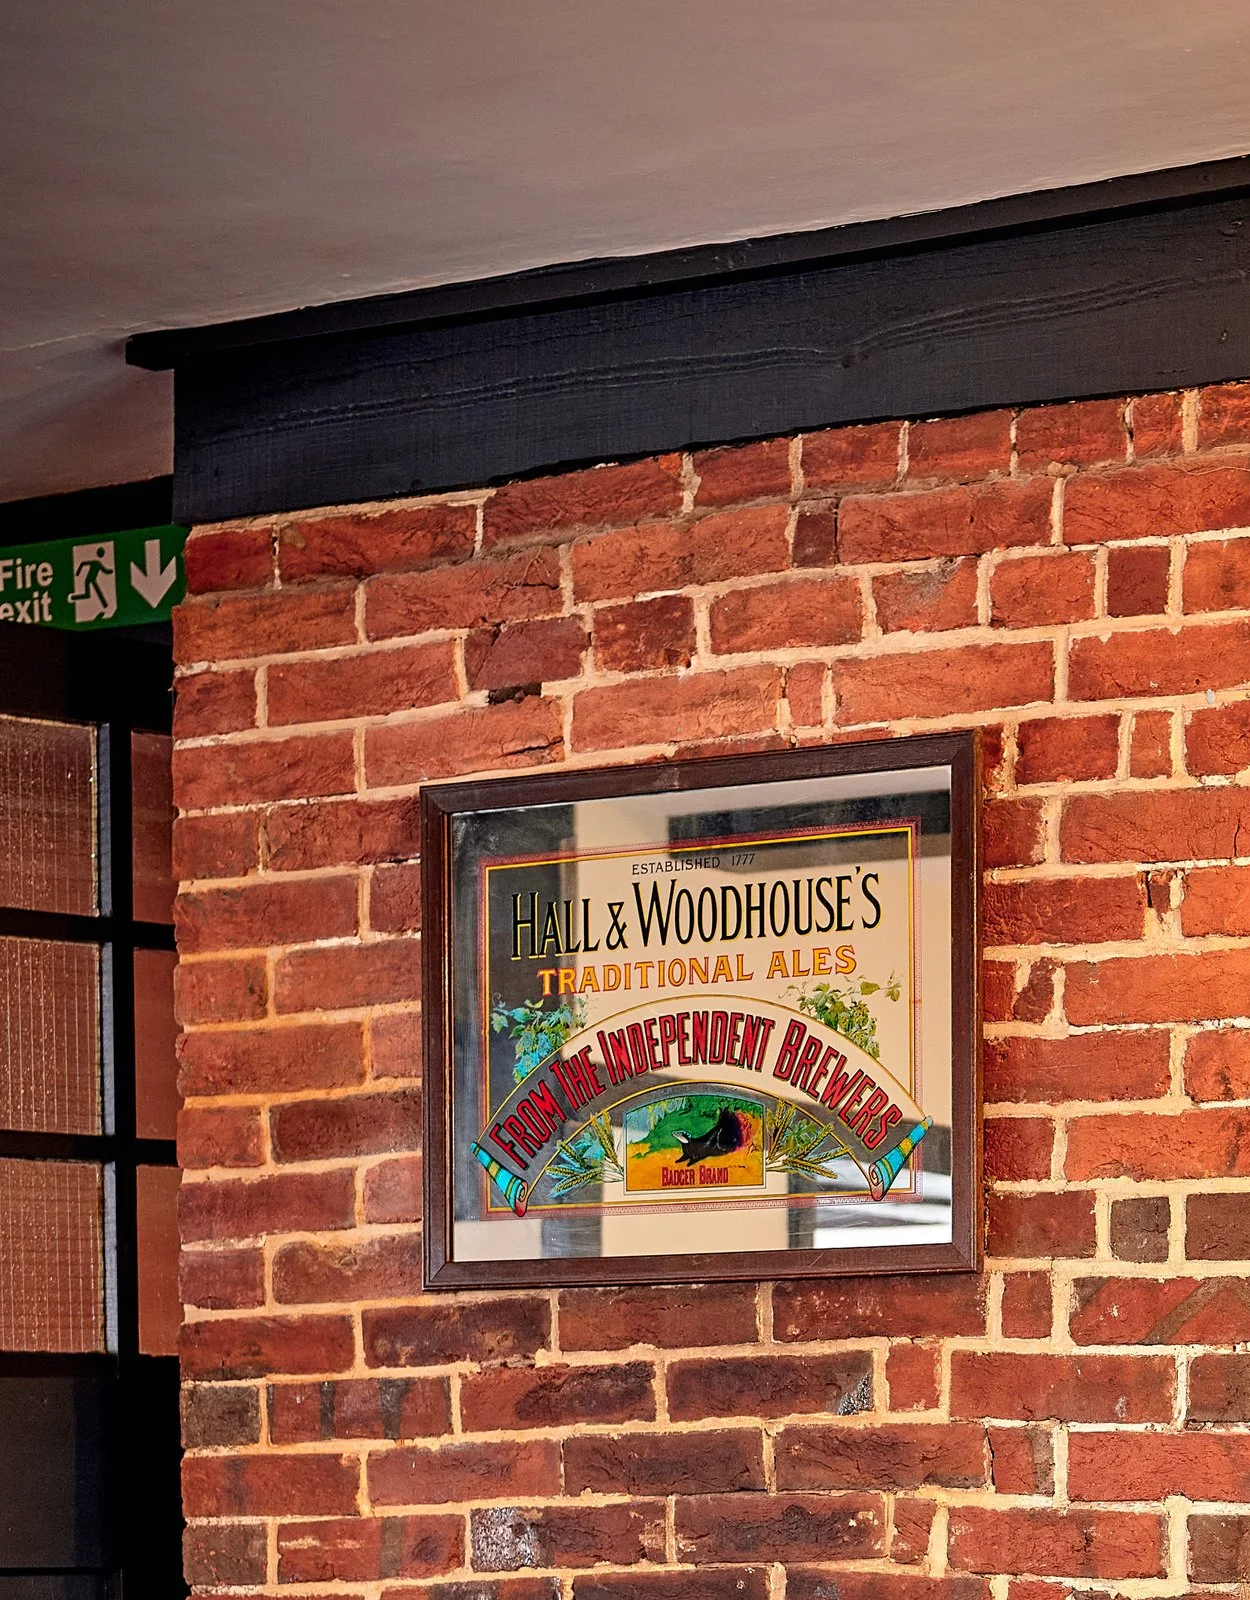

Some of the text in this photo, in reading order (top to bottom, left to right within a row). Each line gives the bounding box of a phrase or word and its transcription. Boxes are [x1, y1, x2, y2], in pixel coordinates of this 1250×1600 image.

[0, 558, 54, 592] Fire
[0, 591, 53, 624] exit
[632, 853, 755, 875] ESTABLISHED 1777
[510, 865, 882, 961] HALL & WOODHOUSE'S
[537, 944, 858, 997] TRADITIONAL ALES
[489, 1009, 904, 1171] FROM THE INDEPENDENT BREWERS
[661, 1164, 729, 1187] BADGER BRAND
